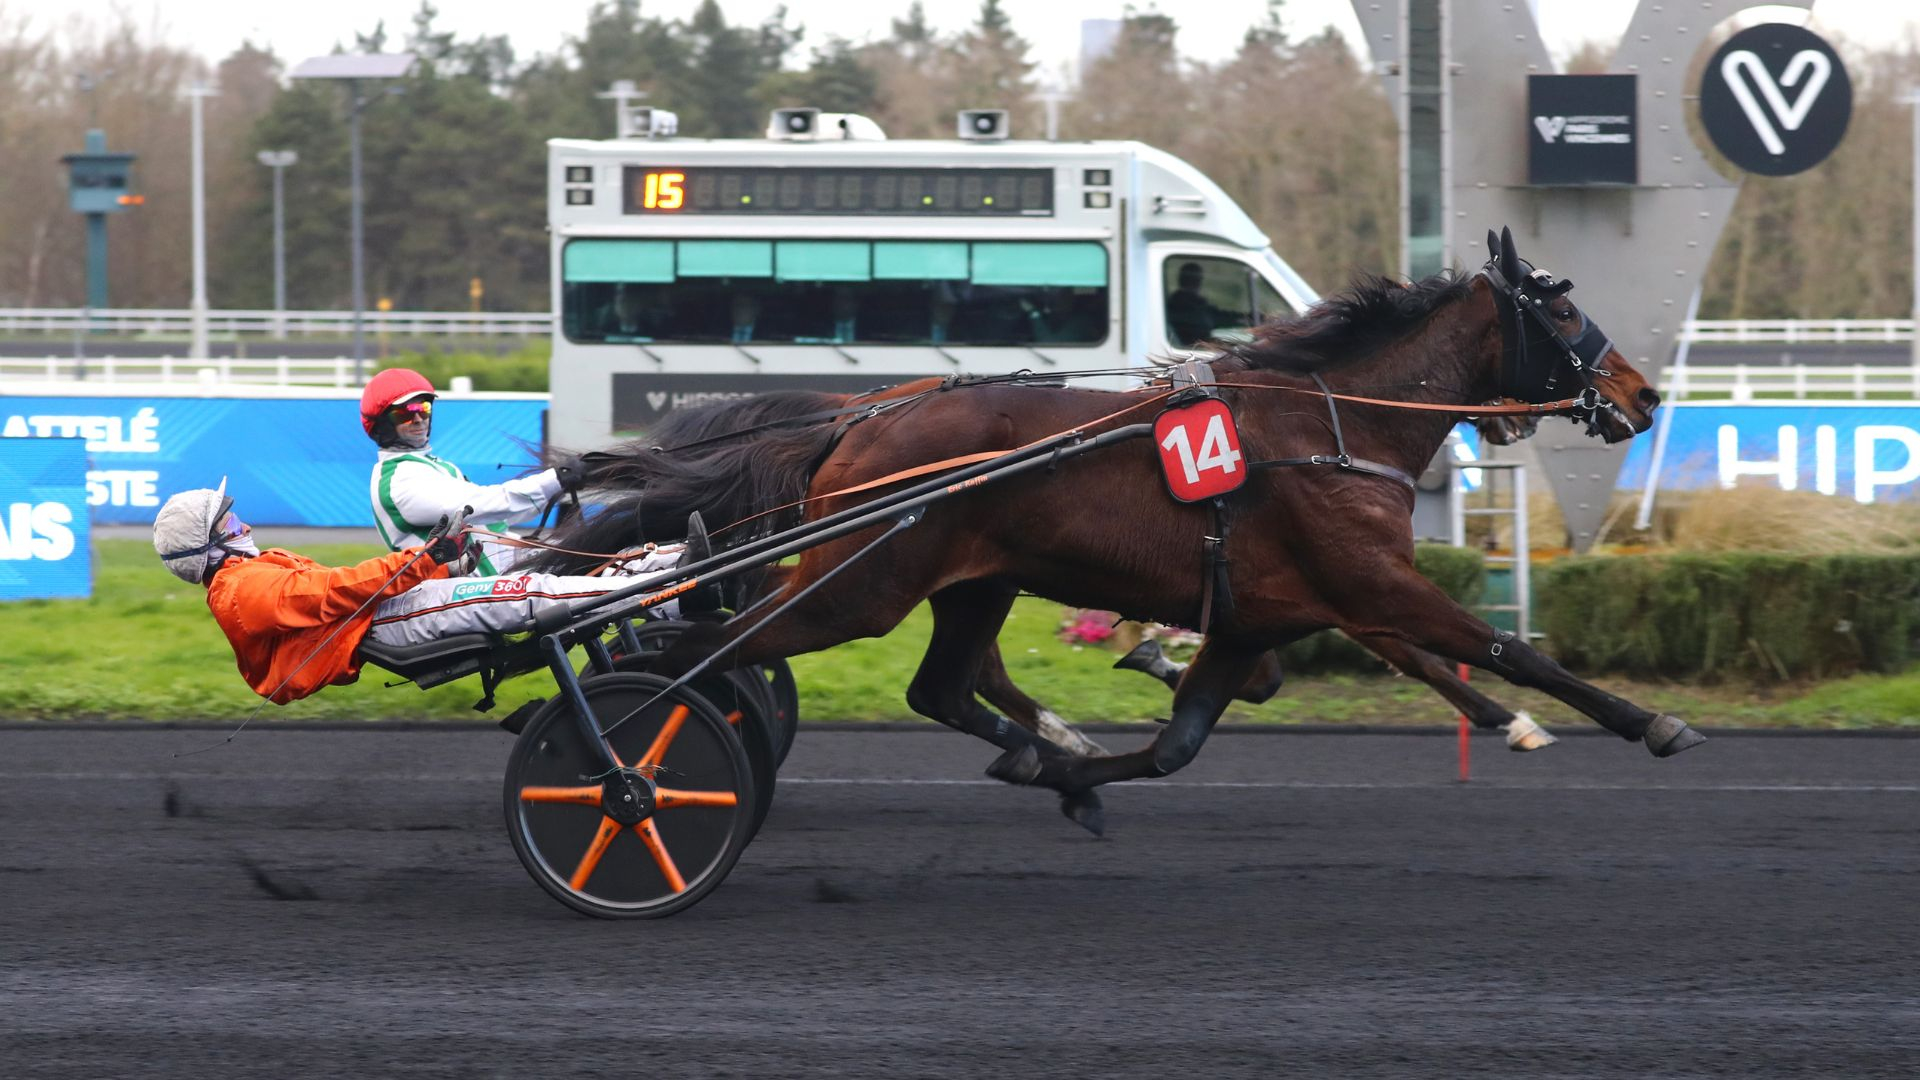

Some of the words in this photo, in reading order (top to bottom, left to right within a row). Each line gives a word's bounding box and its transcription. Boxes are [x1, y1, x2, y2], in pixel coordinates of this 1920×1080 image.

[643, 173, 685, 209] 15
[3, 407, 160, 452] ATTELÉ
[1161, 414, 1241, 485] 14
[1717, 424, 1920, 504] HIP
[456, 583, 492, 595] Geny
